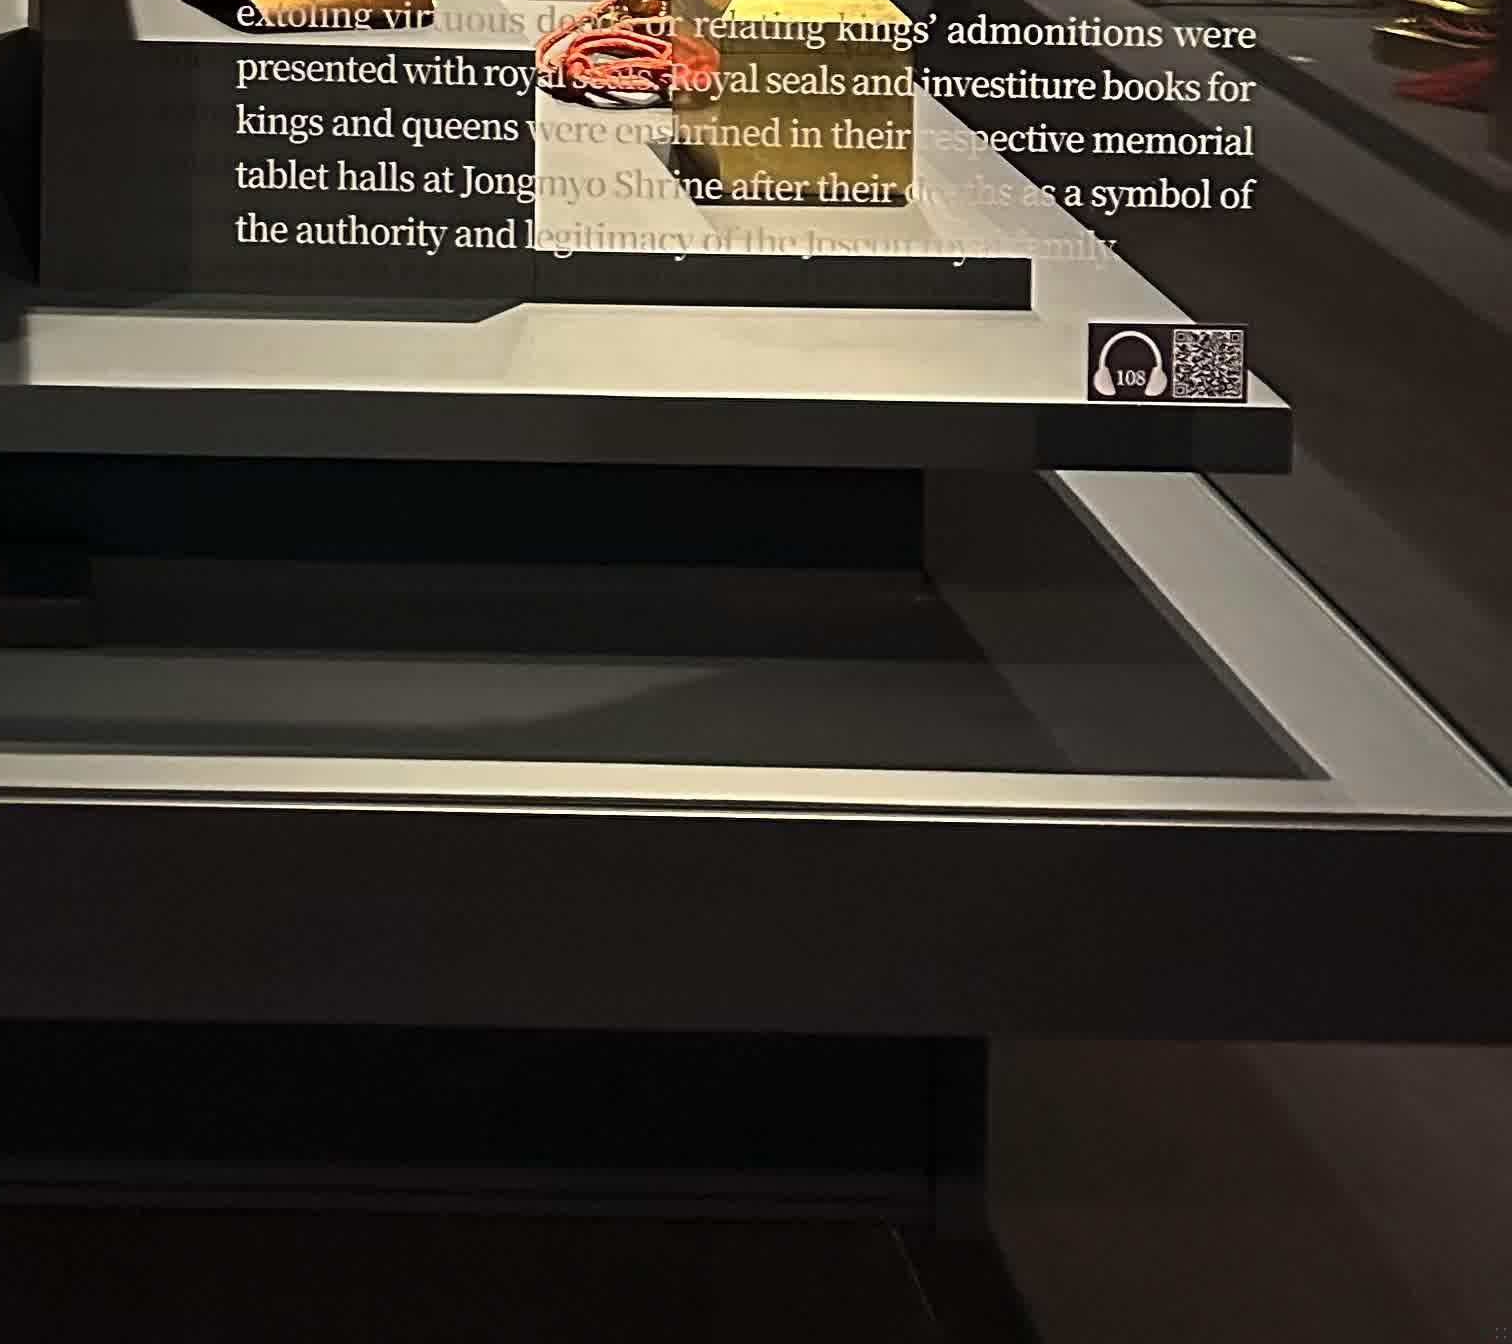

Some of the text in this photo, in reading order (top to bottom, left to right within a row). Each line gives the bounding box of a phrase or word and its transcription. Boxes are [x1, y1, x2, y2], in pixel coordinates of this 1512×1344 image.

[384, 1, 526, 32] virtuous
[695, 10, 824, 49] relating
[947, 13, 1164, 48] admonitions
[1171, 26, 1257, 49] were
[236, 53, 398, 89] presented
[402, 55, 478, 86] with
[484, 57, 566, 96] royal
[670, 63, 759, 100] Royal
[767, 66, 846, 97] seals
[852, 67, 914, 97] and
[921, 67, 1096, 100] investiture
[1101, 69, 1201, 102] books
[1206, 70, 1257, 103] for
[236, 103, 1254, 160] kings and queens were enshrined in their respective memorial
[234, 158, 329, 191] tablet
[337, 160, 415, 193] halls
[423, 167, 455, 194] at
[460, 166, 607, 205] Jongmyo
[615, 169, 722, 200] Shrine
[731, 170, 811, 201] after
[818, 171, 897, 203] their
[1023, 187, 1056, 207] as
[1060, 185, 1084, 211] a
[1091, 177, 1212, 216] symbol
[1220, 178, 1258, 210] of
[295, 214, 449, 256] authority
[454, 218, 517, 249] and
[525, 220, 696, 261] legitimacy
[1116, 369, 1146, 387] 108
